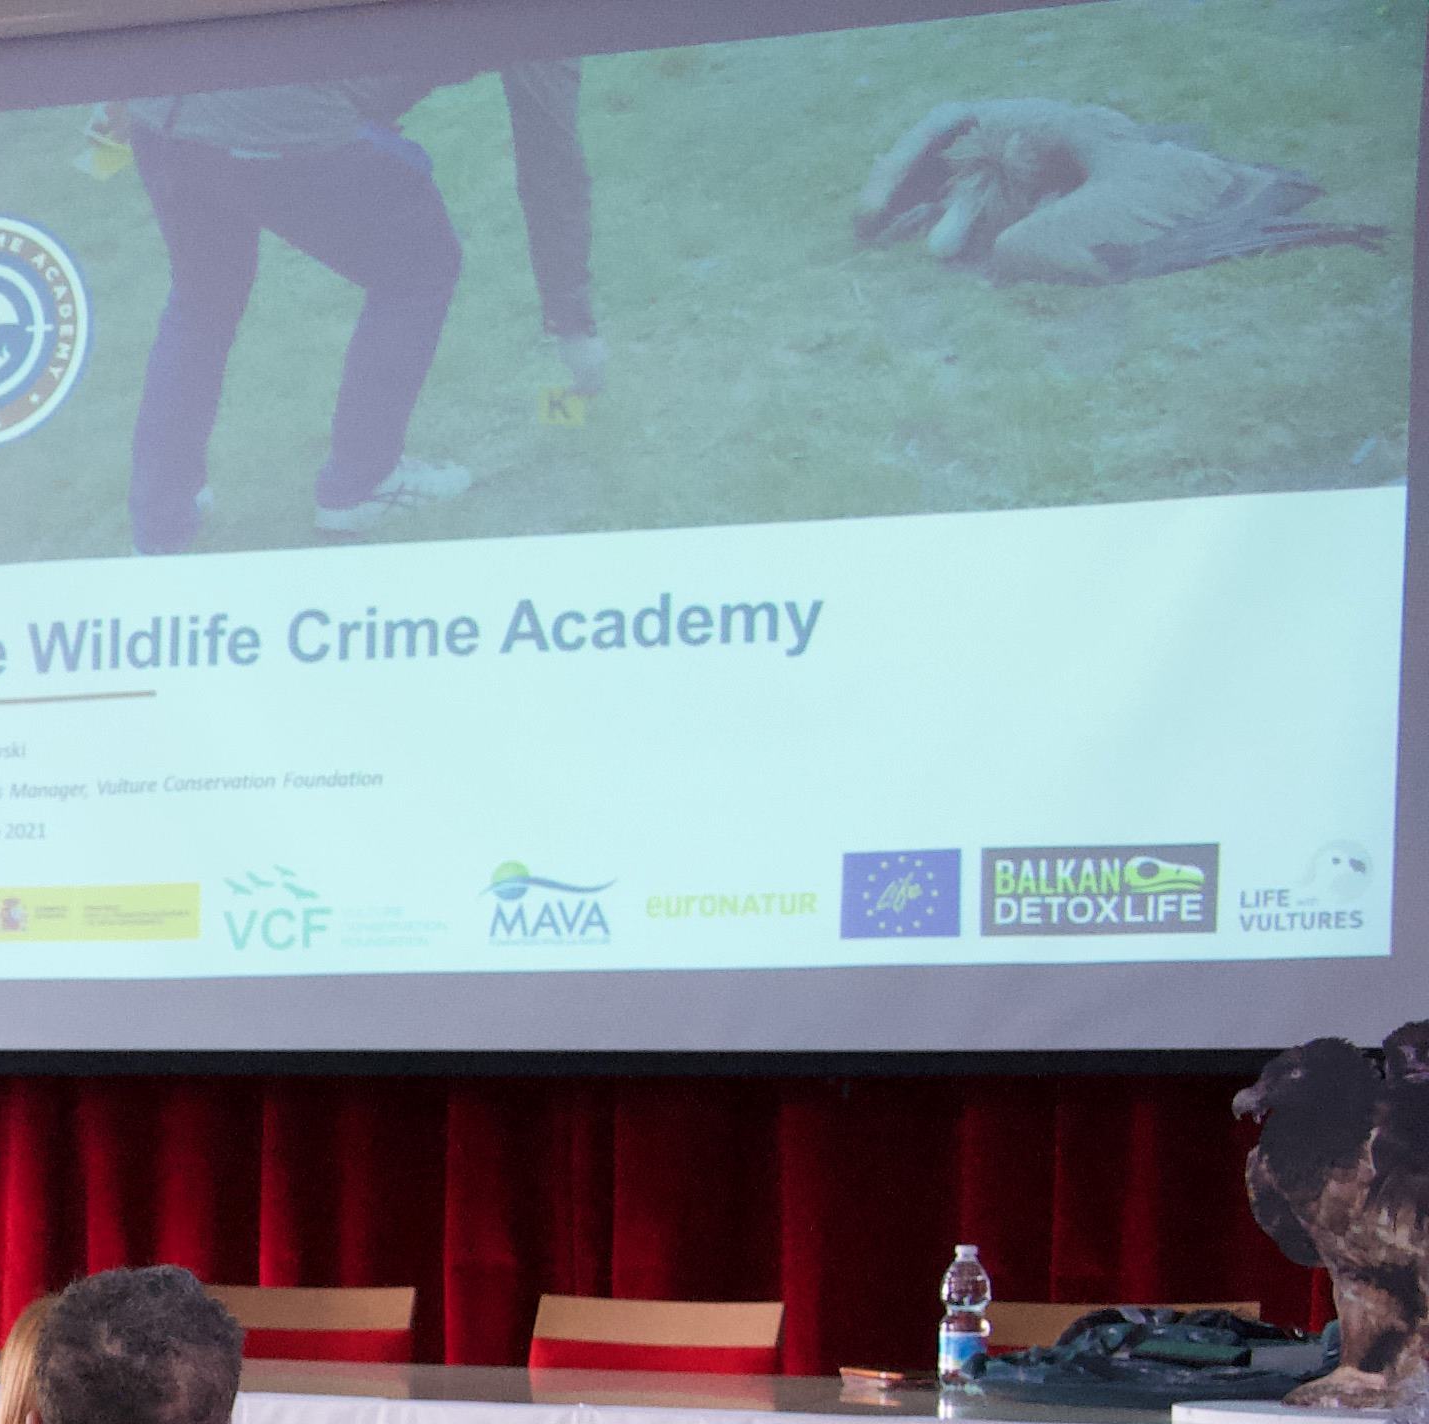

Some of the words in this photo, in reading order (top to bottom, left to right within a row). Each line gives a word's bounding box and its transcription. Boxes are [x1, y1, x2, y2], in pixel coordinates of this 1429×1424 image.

[31, 252, 74, 380] ACADEMY
[27, 612, 263, 675] Wildlife
[285, 605, 482, 664] Crime
[499, 591, 825, 658] Academy
[97, 776, 159, 796] Vulture
[163, 772, 277, 793] Conservation
[283, 769, 384, 789] Foundation
[4, 822, 46, 841] 2021
[994, 856, 1122, 896] BALKAN
[1239, 888, 1291, 909] LIFE
[223, 905, 333, 951] VCF
[489, 900, 610, 938] MAVA
[1238, 910, 1365, 932] VULTURES
